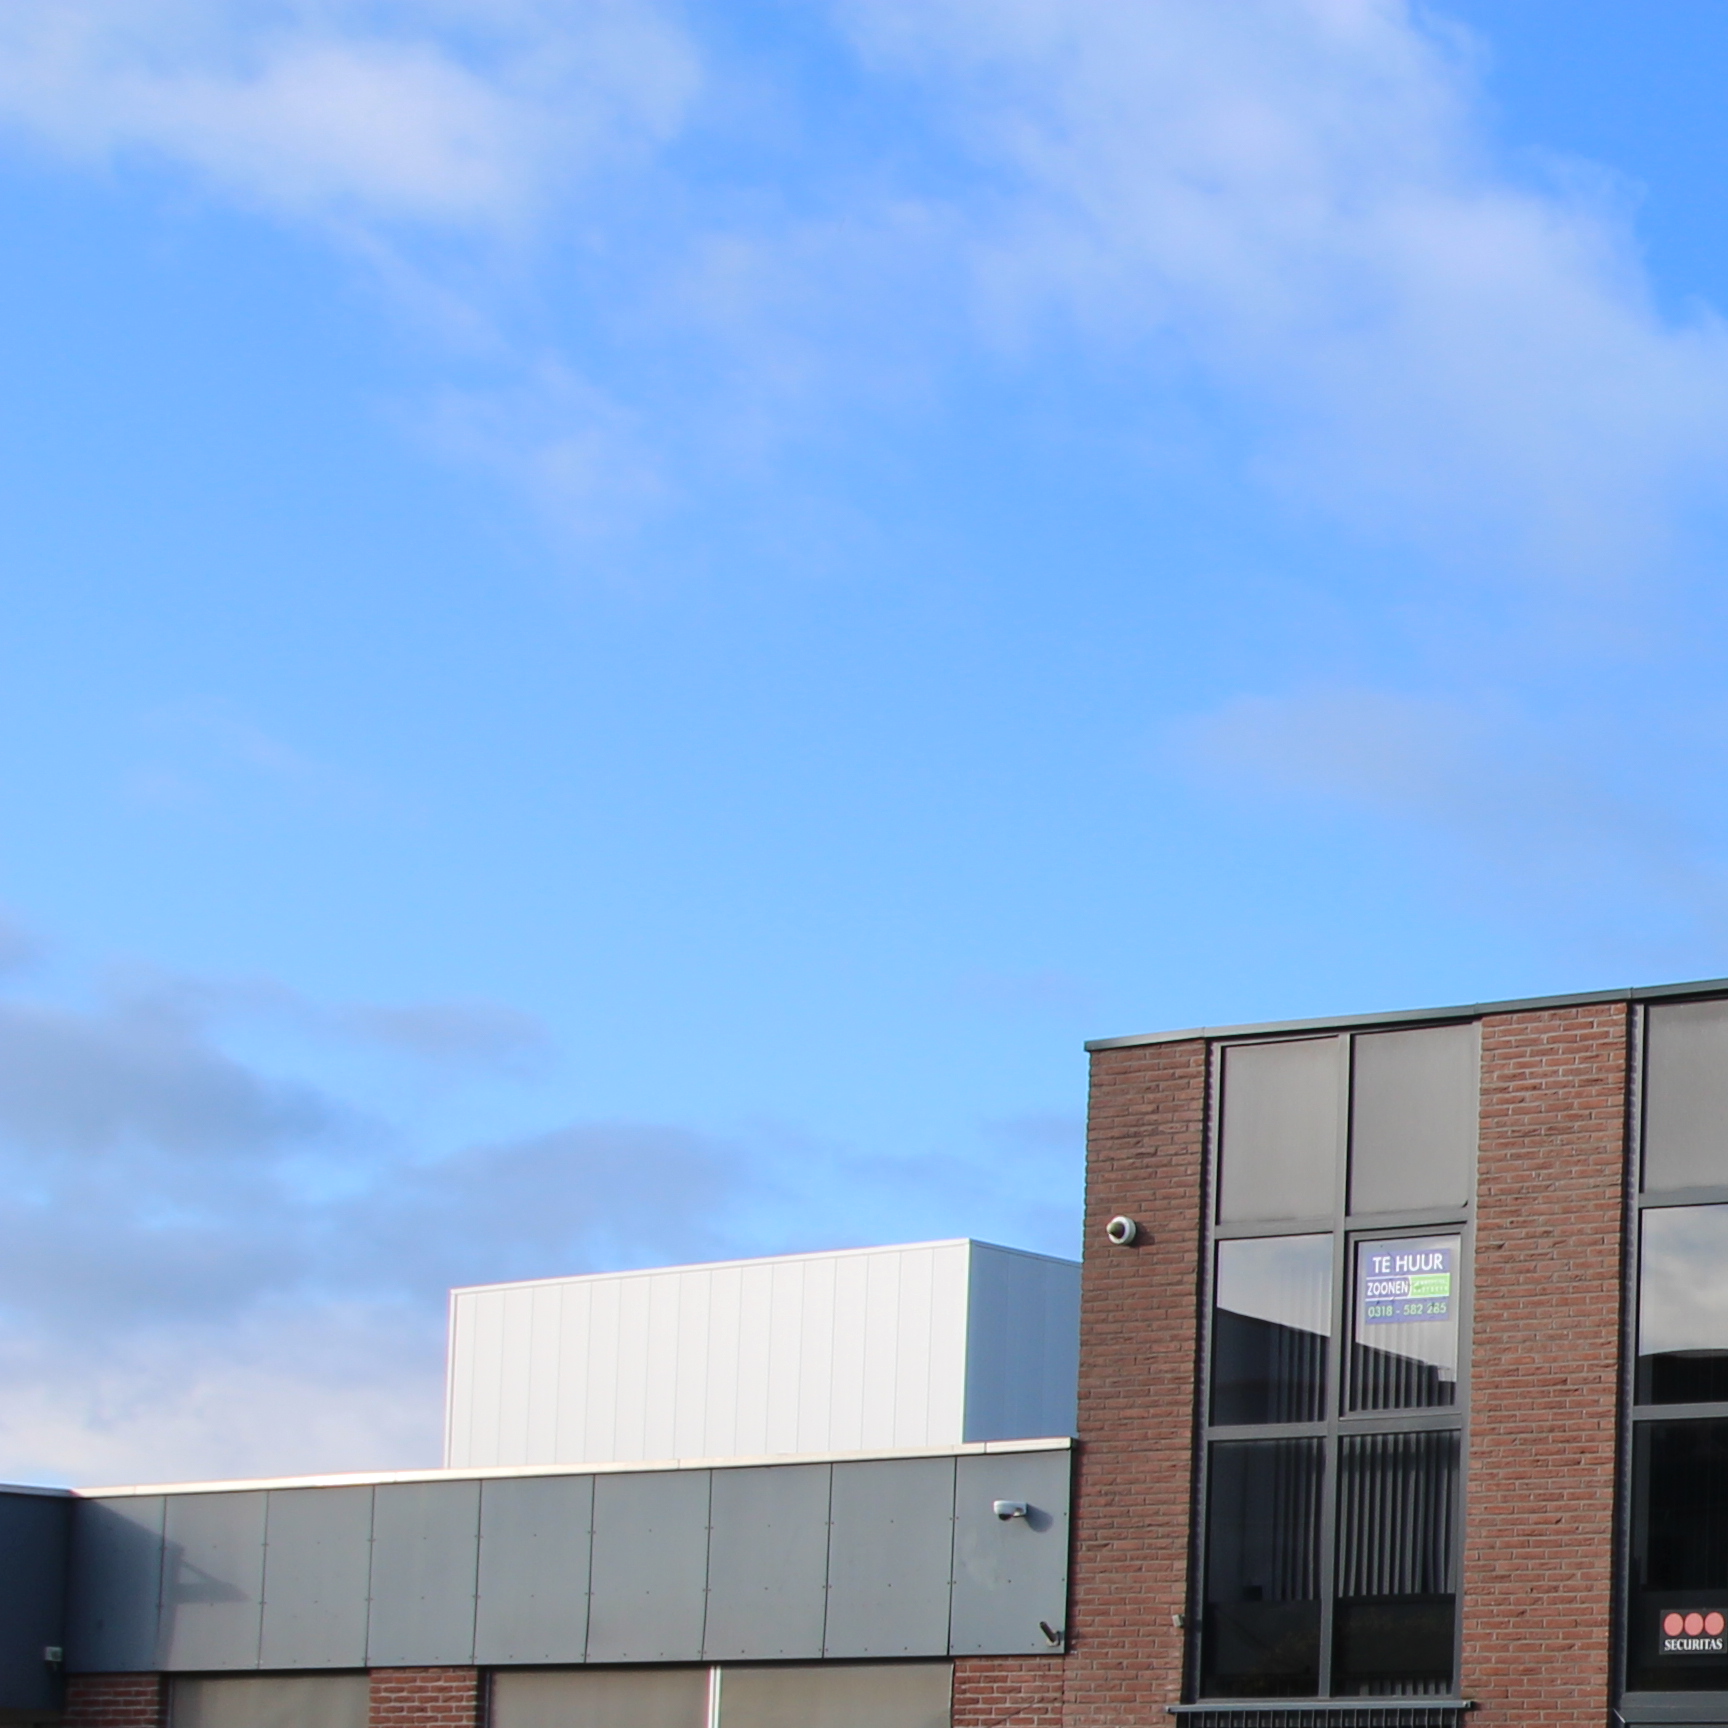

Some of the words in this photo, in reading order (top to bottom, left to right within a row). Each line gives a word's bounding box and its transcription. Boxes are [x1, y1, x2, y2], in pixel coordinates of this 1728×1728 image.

[1372, 1256, 1391, 1273] TE
[1395, 1253, 1443, 1272] HUUR
[1367, 1281, 1409, 1296] ZOONEN
[1368, 1305, 1393, 1318] 0318
[1403, 1303, 1423, 1316] 582
[1664, 1638, 1723, 1651] SECURITAS
